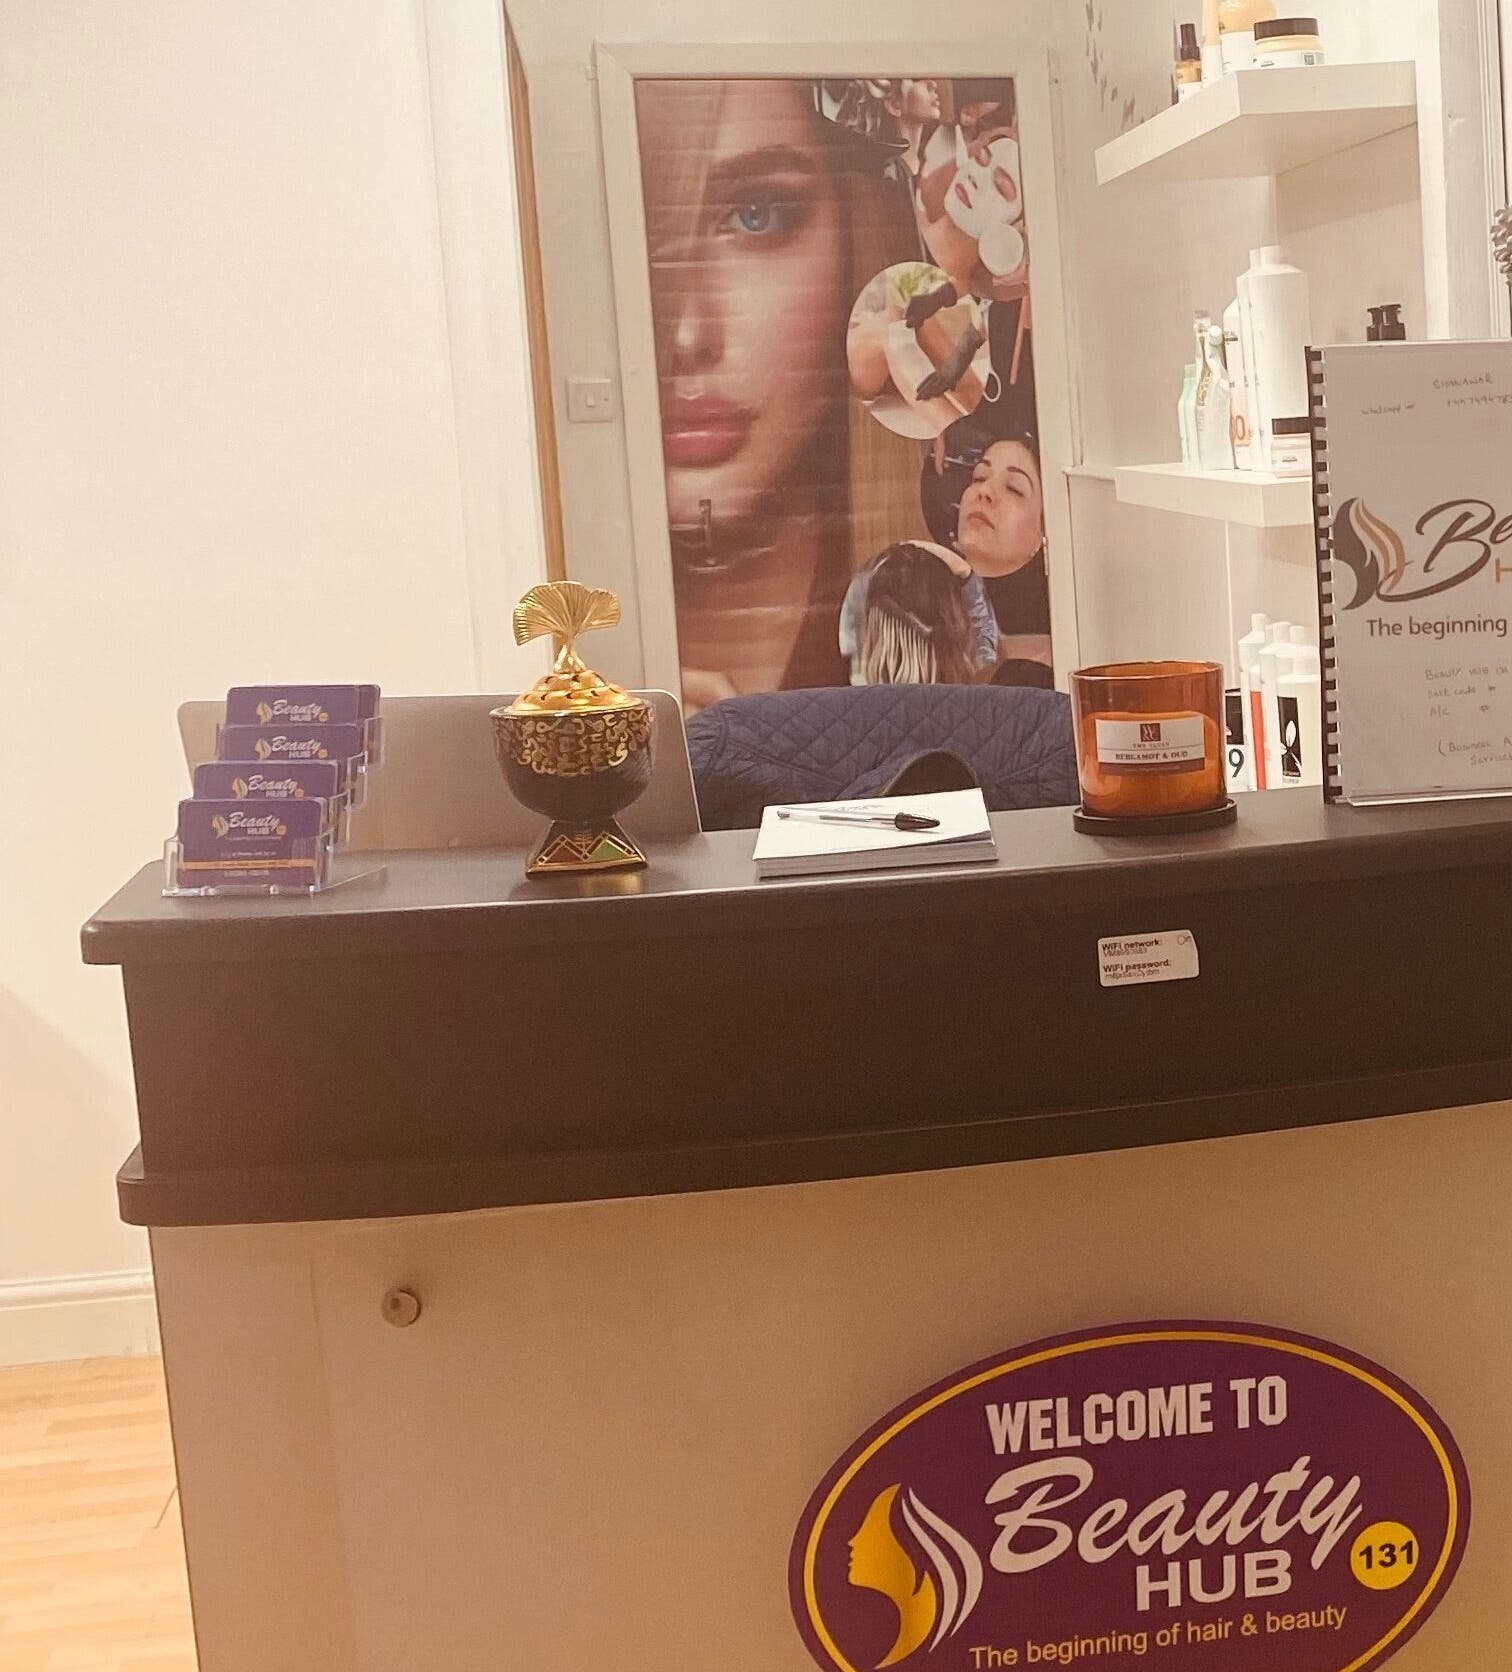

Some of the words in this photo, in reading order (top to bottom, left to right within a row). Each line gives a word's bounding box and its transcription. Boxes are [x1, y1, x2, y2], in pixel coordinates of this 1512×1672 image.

[1366, 617, 1403, 638] The
[1409, 613, 1509, 640] beginning
[272, 699, 323, 719] Beauty
[271, 735, 322, 754] Beauty
[1170, 750, 1188, 759] OUD
[248, 774, 299, 793] Beauty
[228, 811, 280, 830] Beauty
[985, 1382, 1213, 1455] WELCOME
[1230, 1375, 1287, 1429] TO
[985, 1456, 1363, 1573] Beauty
[1358, 1540, 1415, 1570] 131
[1136, 1549, 1292, 1611] HUB
[969, 1644, 1018, 1670] The
[1026, 1629, 1148, 1665] beginning
[1156, 1622, 1181, 1647] of
[1188, 1617, 1232, 1643] hair
[1240, 1613, 1259, 1635] &
[1266, 1605, 1348, 1634] beauty
